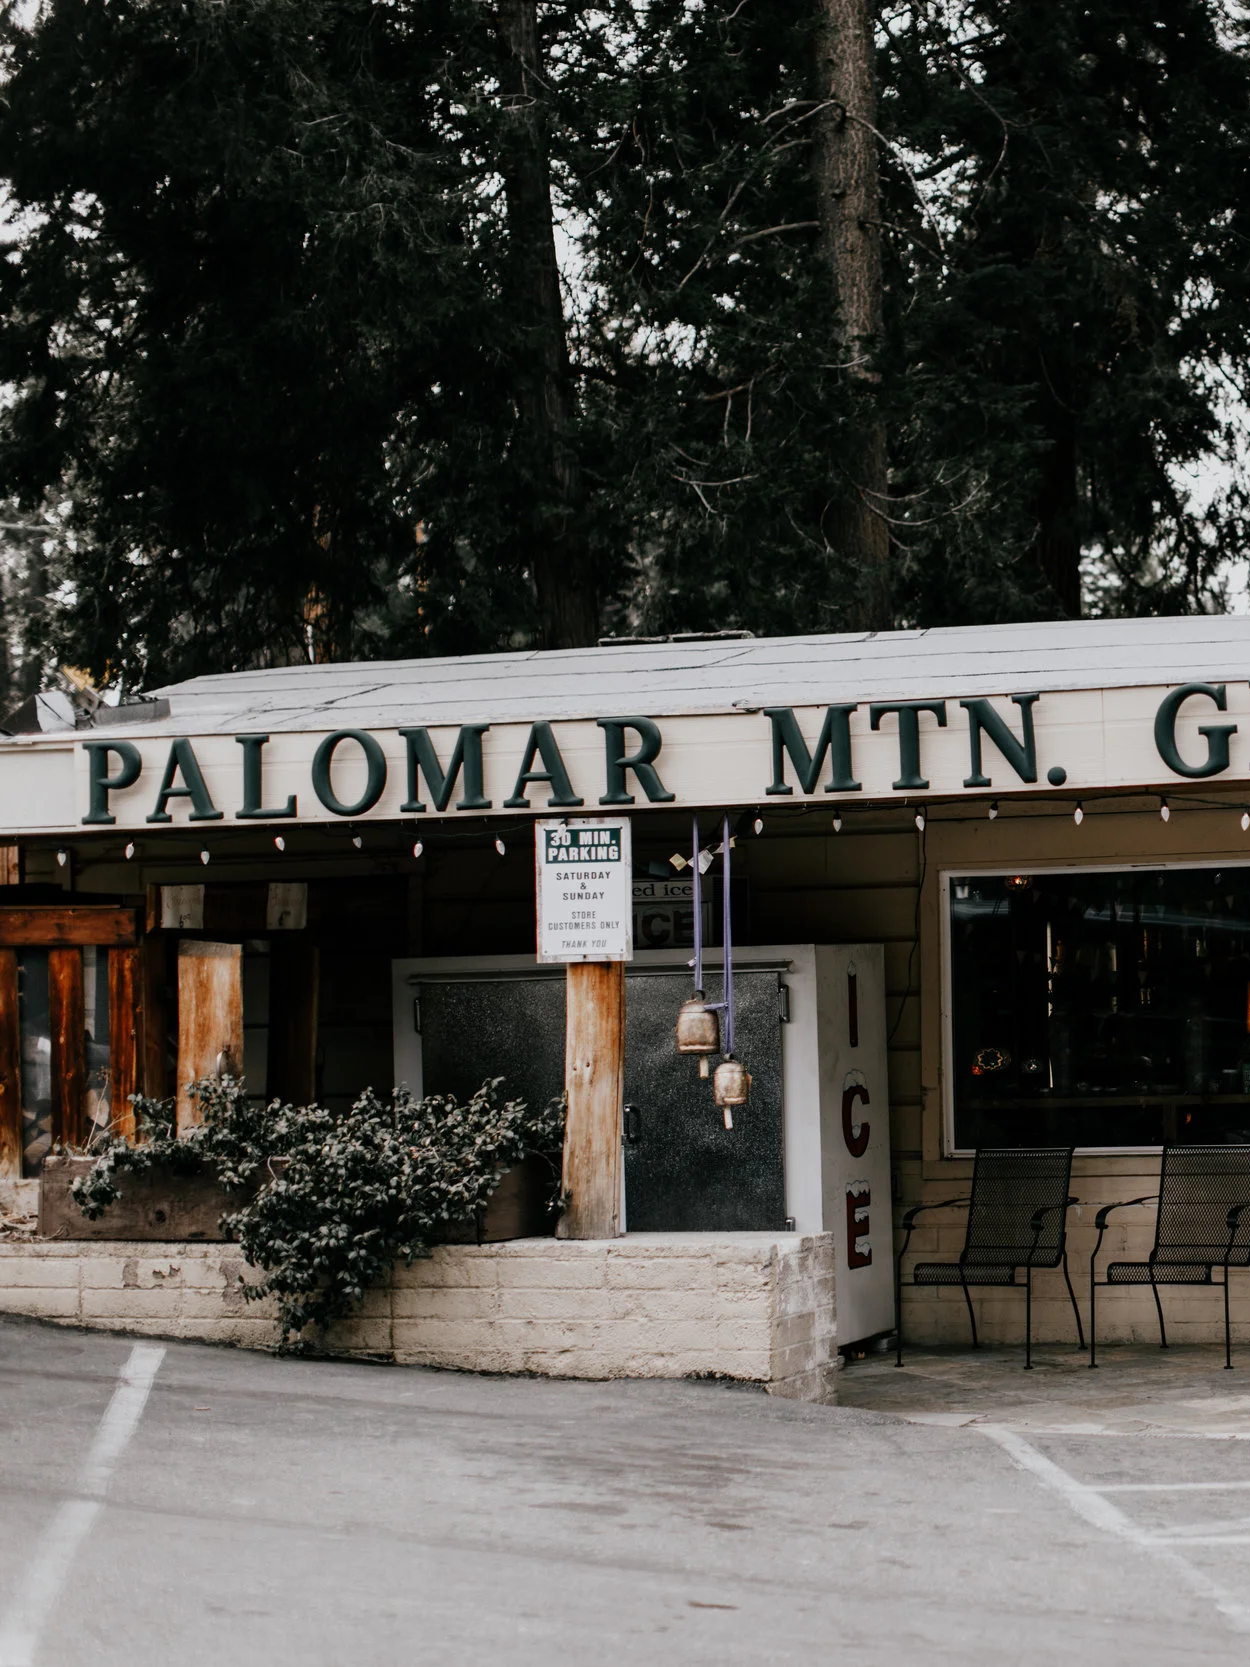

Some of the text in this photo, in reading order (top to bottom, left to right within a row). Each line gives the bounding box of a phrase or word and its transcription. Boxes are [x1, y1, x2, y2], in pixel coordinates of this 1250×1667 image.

[81, 716, 676, 825] PALOMAR
[763, 692, 1067, 796] MTN.
[550, 831, 616, 846] 30 MIN.
[548, 846, 619, 861] PARKING
[556, 871, 611, 881] SATURDAY
[579, 882, 587, 890] &
[663, 884, 693, 897] ice
[563, 892, 605, 900] SUNDAY
[571, 911, 597, 919] STORE
[548, 920, 620, 931] CUSTOMERS ONLY
[561, 939, 607, 949] THANK YOU
